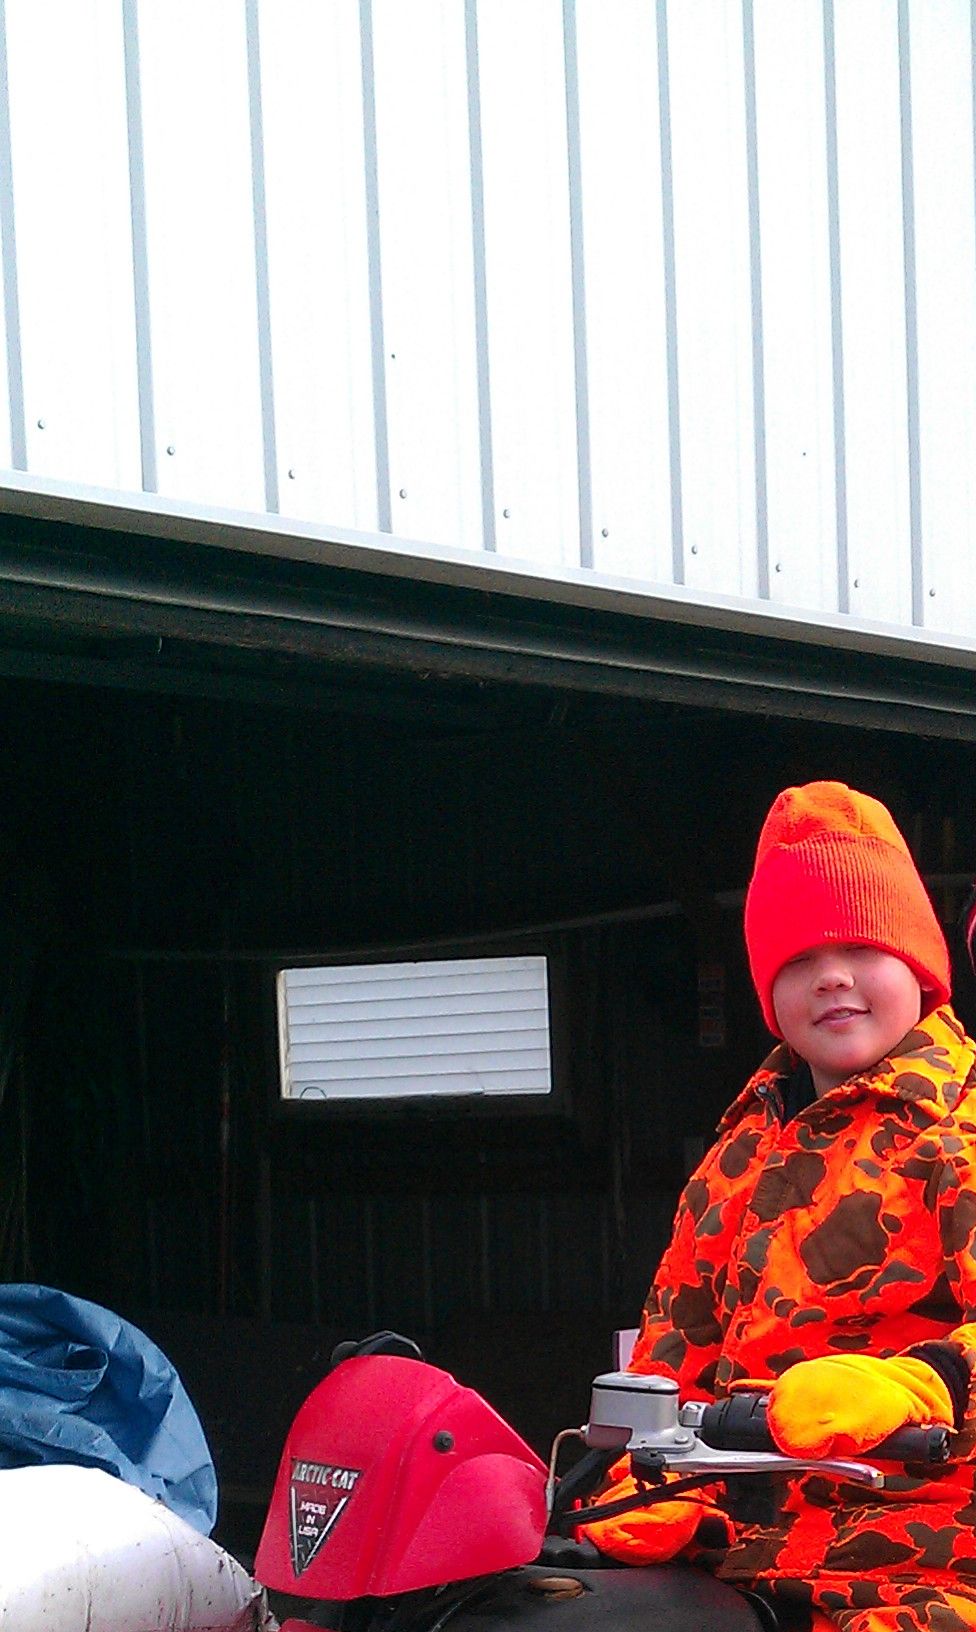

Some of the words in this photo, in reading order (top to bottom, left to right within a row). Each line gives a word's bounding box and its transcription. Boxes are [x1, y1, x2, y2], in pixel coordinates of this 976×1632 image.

[292, 1461, 331, 1486] ARCTIC
[331, 1469, 359, 1490] CAT
[300, 1501, 327, 1515] MADE
[306, 1515, 316, 1524] IN
[298, 1525, 319, 1538] USA
